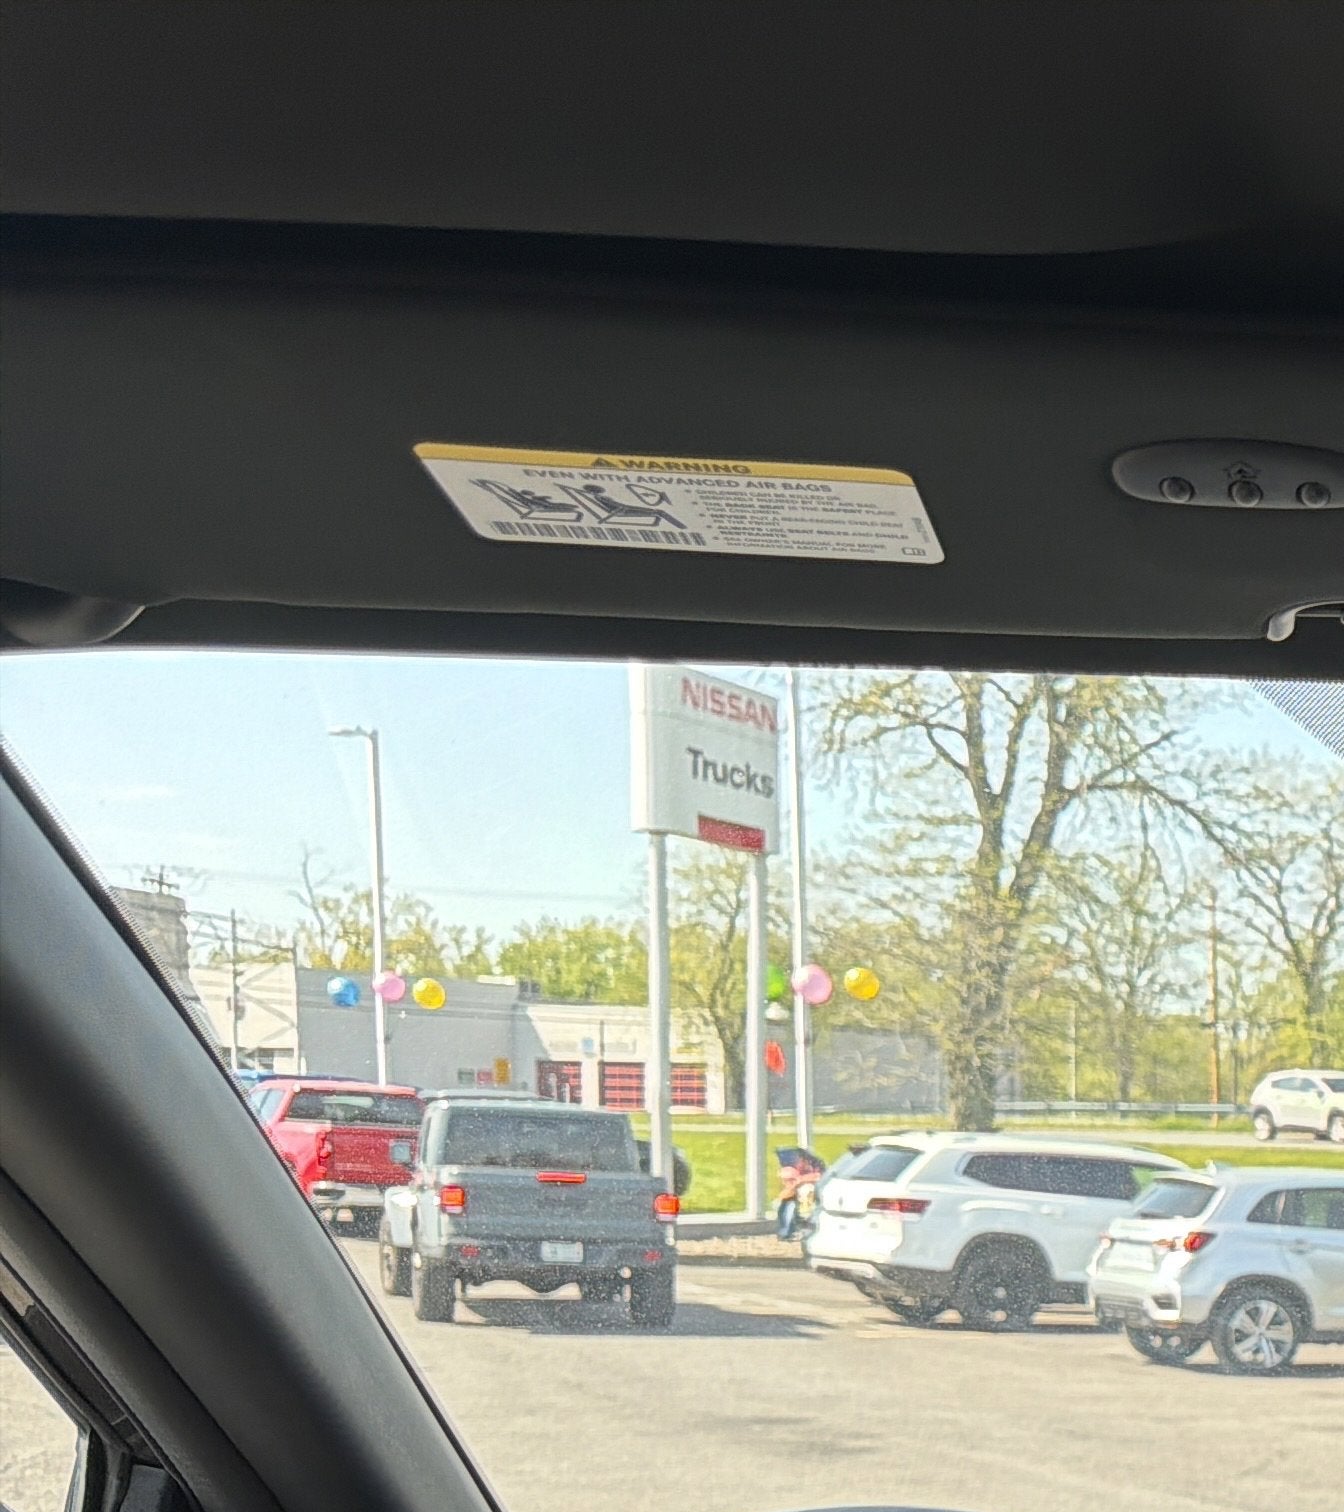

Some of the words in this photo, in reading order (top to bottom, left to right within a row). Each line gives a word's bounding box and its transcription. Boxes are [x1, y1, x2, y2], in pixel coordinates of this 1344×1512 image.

[523, 469, 576, 480] EVEN
[579, 472, 631, 483] WITH
[636, 475, 740, 488] ADVANCED
[745, 480, 777, 490] AIR
[783, 482, 832, 493] BAGS
[620, 459, 751, 474] WARNING
[681, 676, 777, 734] NISSAN
[686, 745, 775, 799] Trucks
